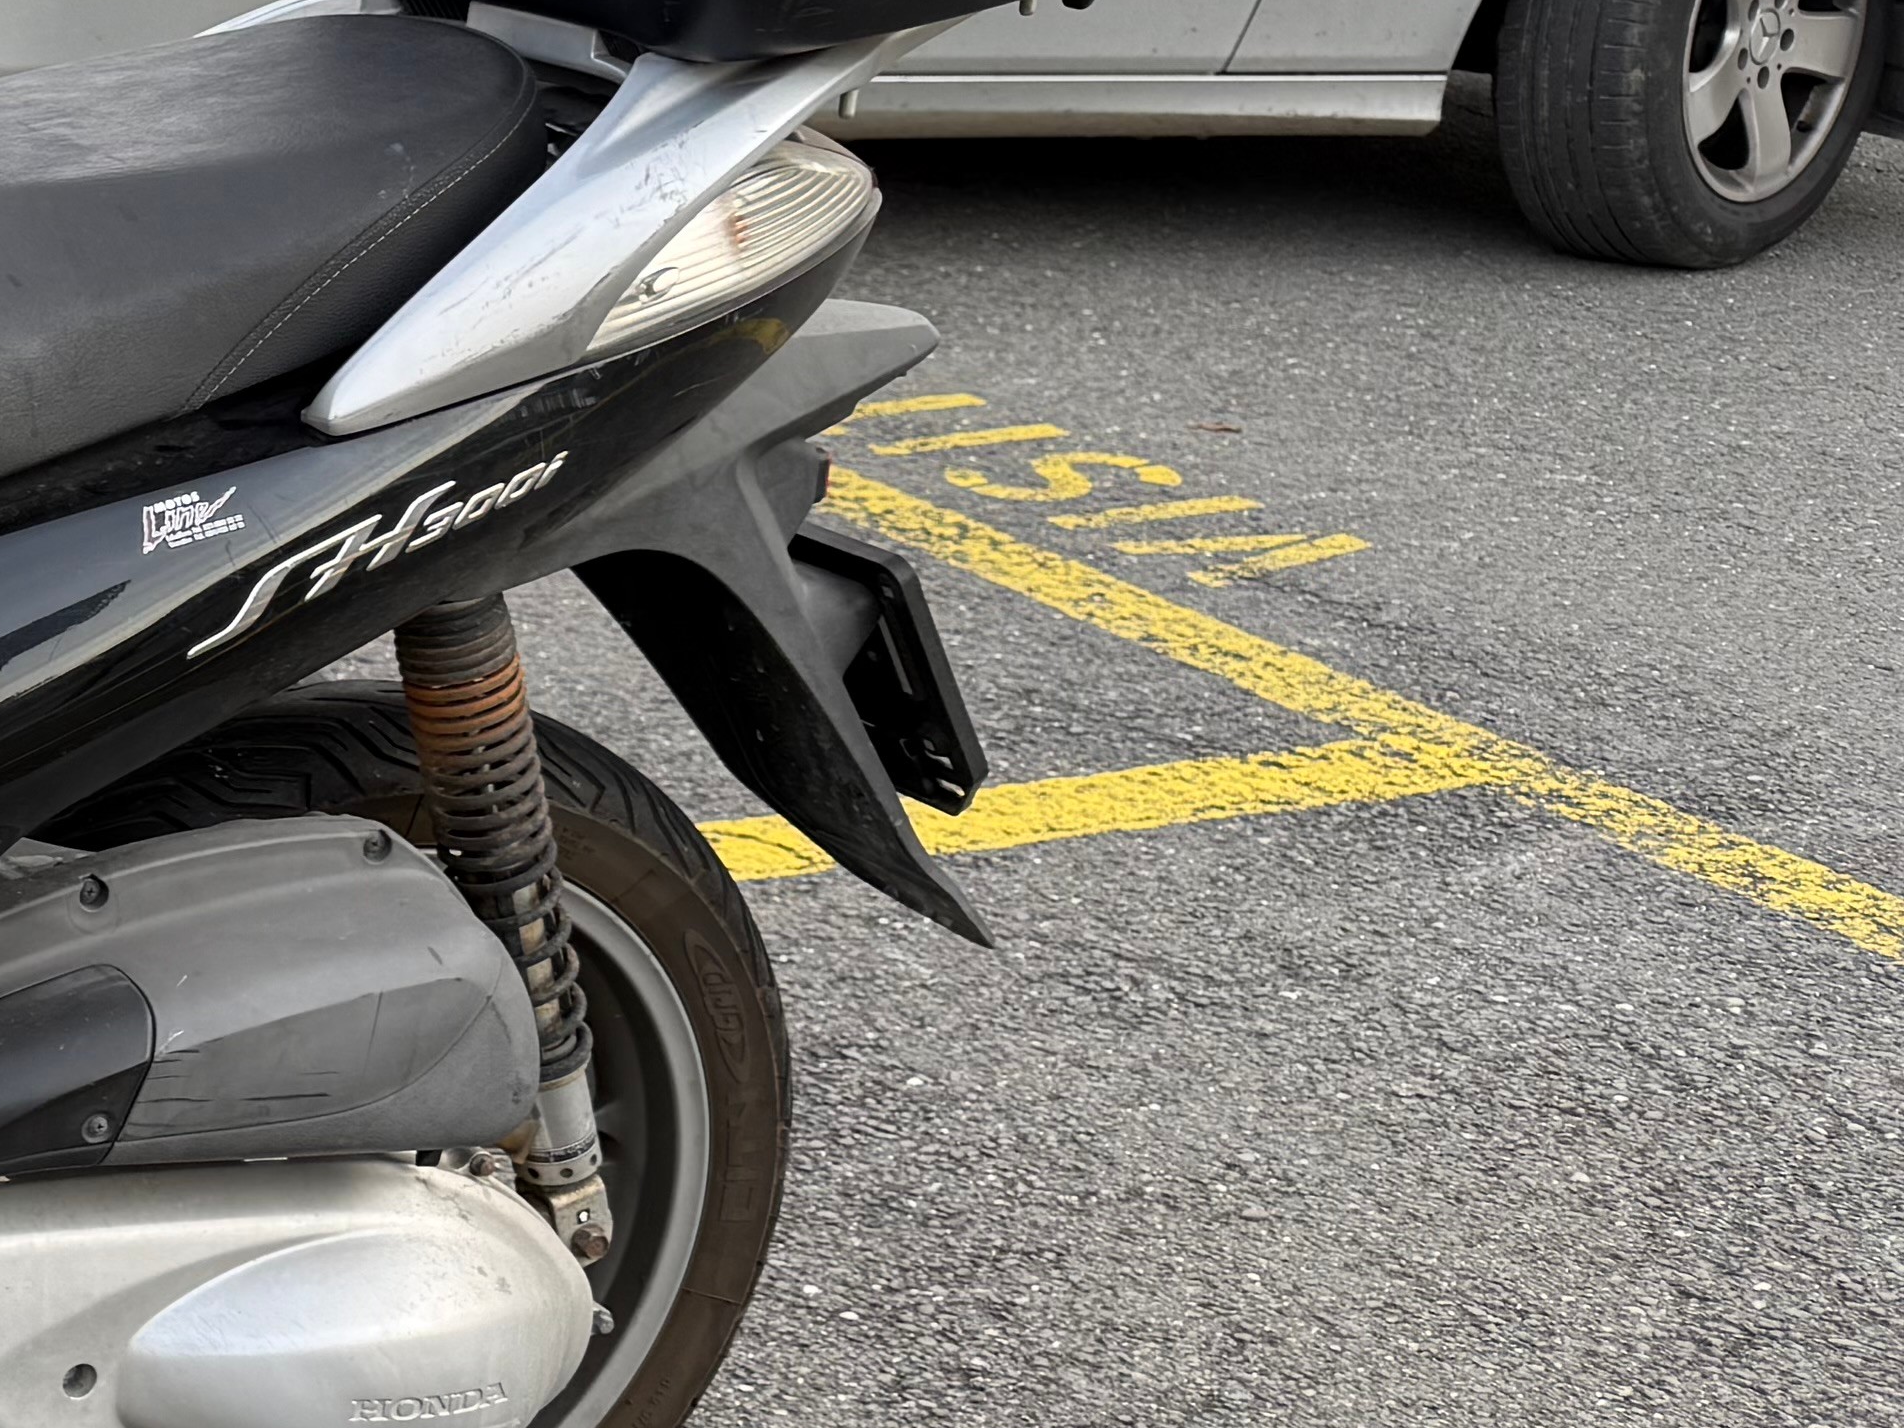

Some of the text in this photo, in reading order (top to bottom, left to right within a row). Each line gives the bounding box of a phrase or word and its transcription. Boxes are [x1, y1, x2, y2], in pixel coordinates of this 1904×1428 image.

[154, 491, 200, 513] MOTOS
[187, 451, 568, 659] SH300i
[348, 1382, 508, 1422] HONDA
